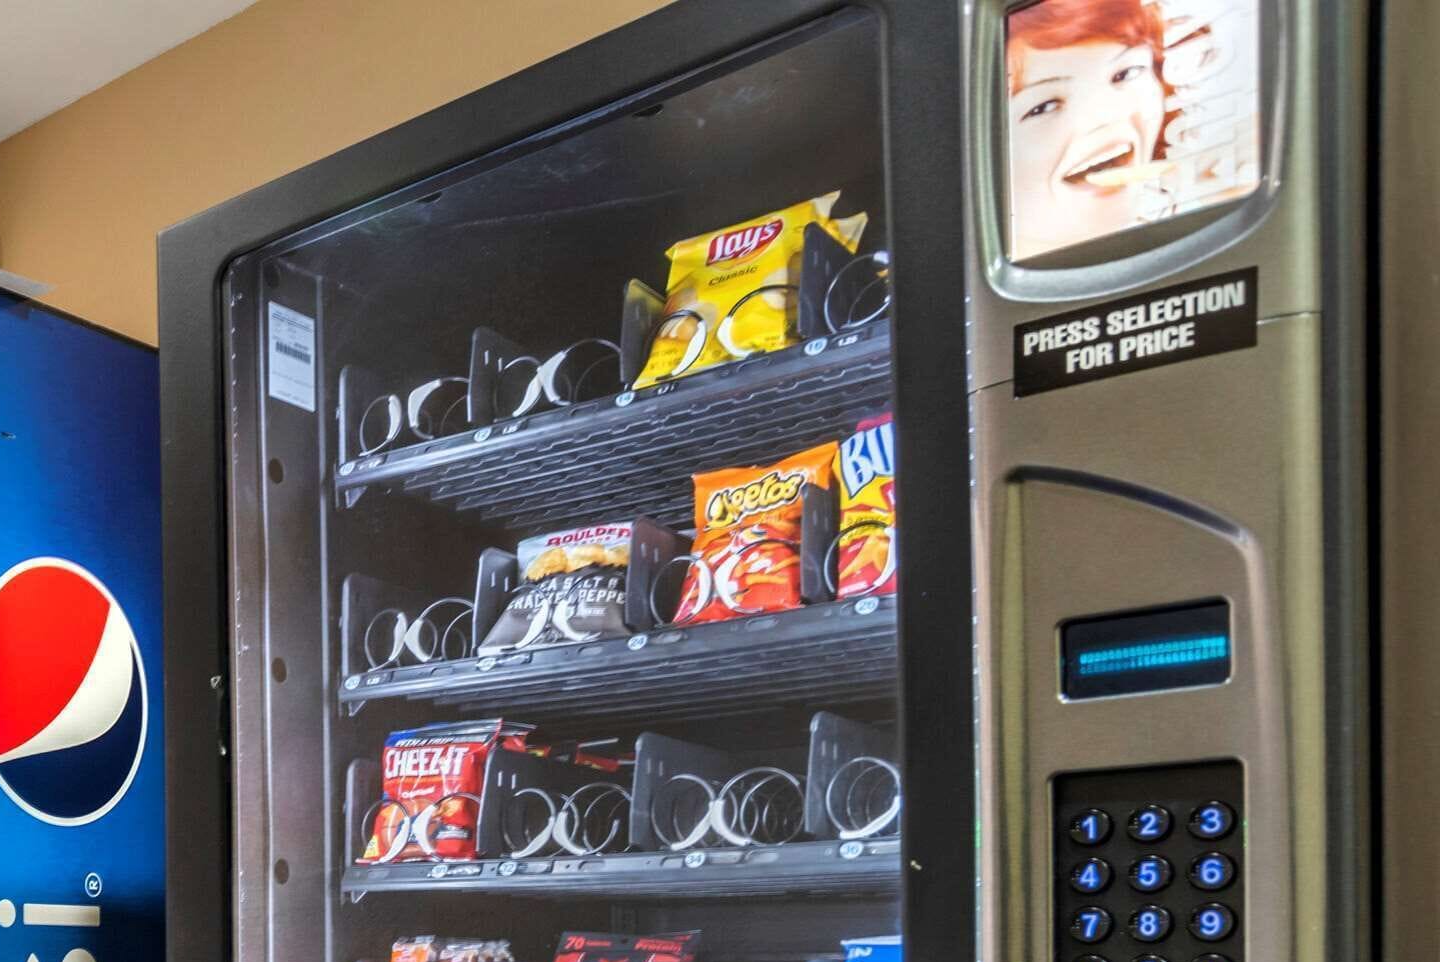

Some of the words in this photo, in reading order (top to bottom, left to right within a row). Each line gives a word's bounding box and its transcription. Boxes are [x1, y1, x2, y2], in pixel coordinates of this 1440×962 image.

[1023, 315, 1101, 356] PRESS
[1106, 280, 1246, 335] SELECTION
[1065, 343, 1115, 374] FOR
[1119, 322, 1195, 361] PRICE
[1082, 815, 1097, 840] 1
[1138, 812, 1158, 835] 2
[1200, 808, 1221, 833] 3
[1079, 864, 1098, 888] 4
[1138, 862, 1157, 886] 5
[1201, 859, 1222, 884] 6
[1081, 913, 1098, 938] 7
[1139, 911, 1158, 936] 8
[1200, 911, 1221, 936] 9
